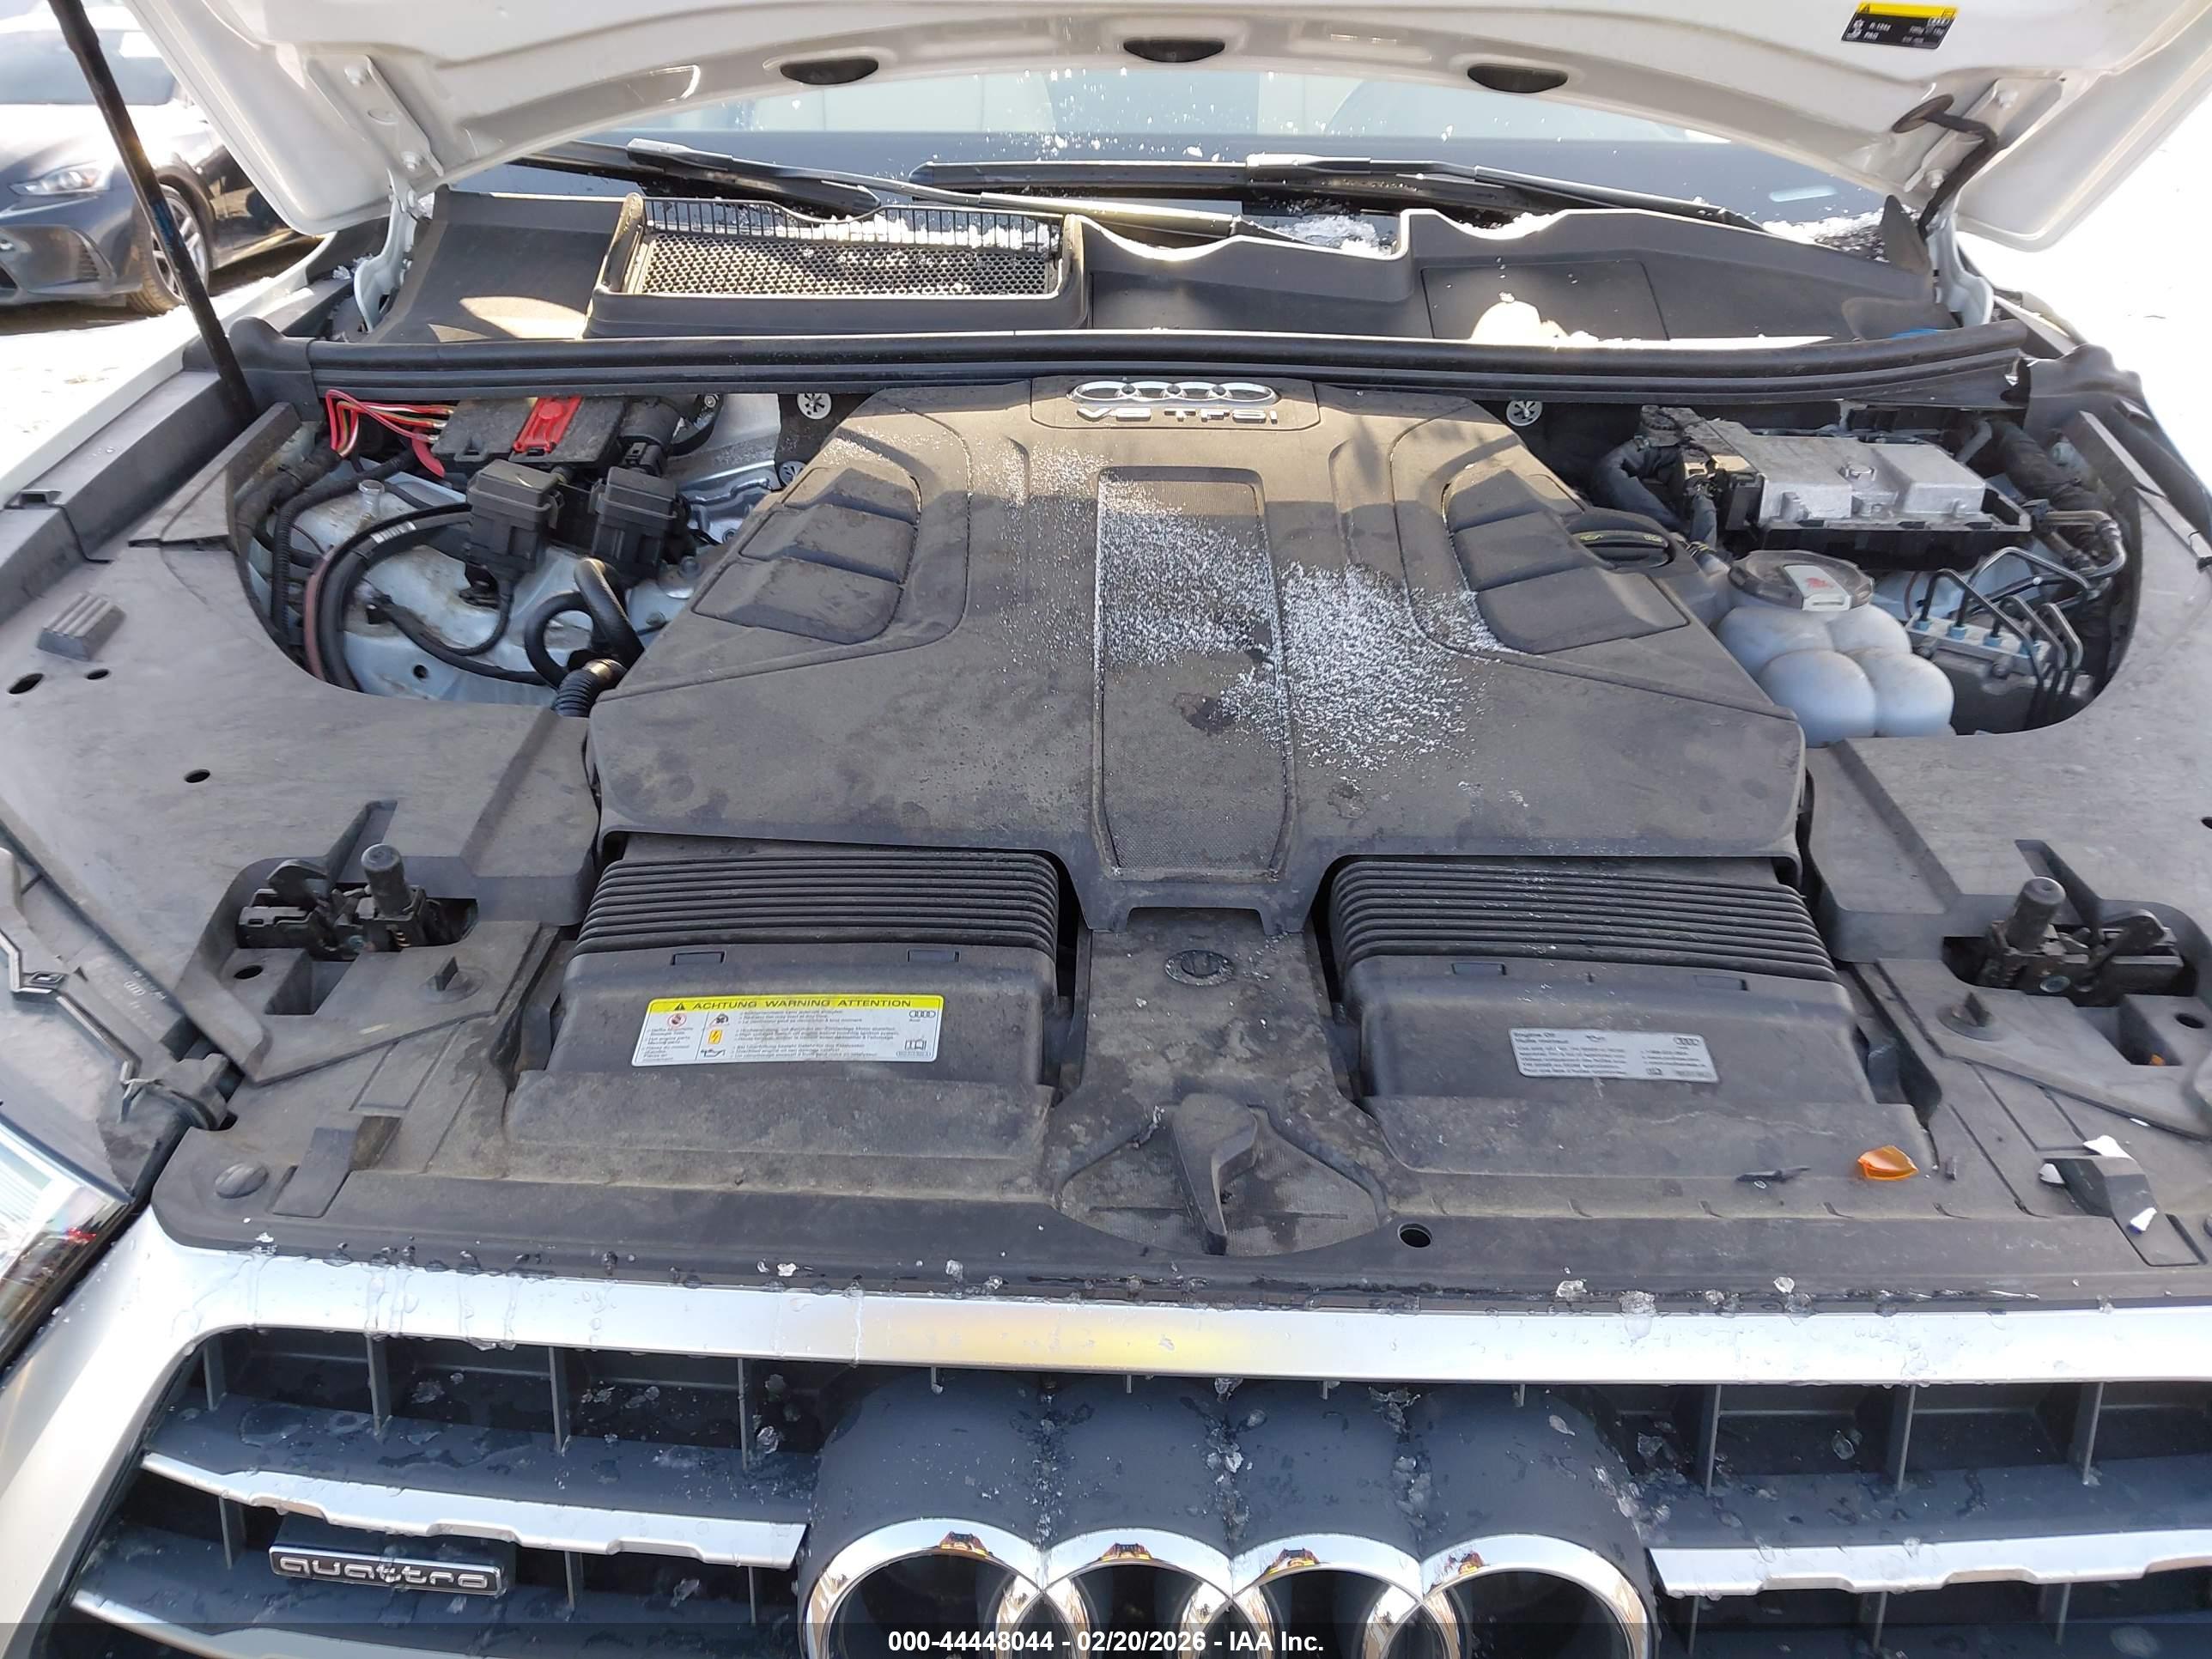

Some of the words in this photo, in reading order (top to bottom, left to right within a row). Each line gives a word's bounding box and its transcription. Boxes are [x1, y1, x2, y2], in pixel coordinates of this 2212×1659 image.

[1164, 408, 1279, 425] TFSI
[692, 1000, 757, 1010] ACHTUNG
[765, 1000, 831, 1008] WARNING
[837, 999, 912, 1008] ATTENTION
[280, 1556, 489, 1589] quattro
